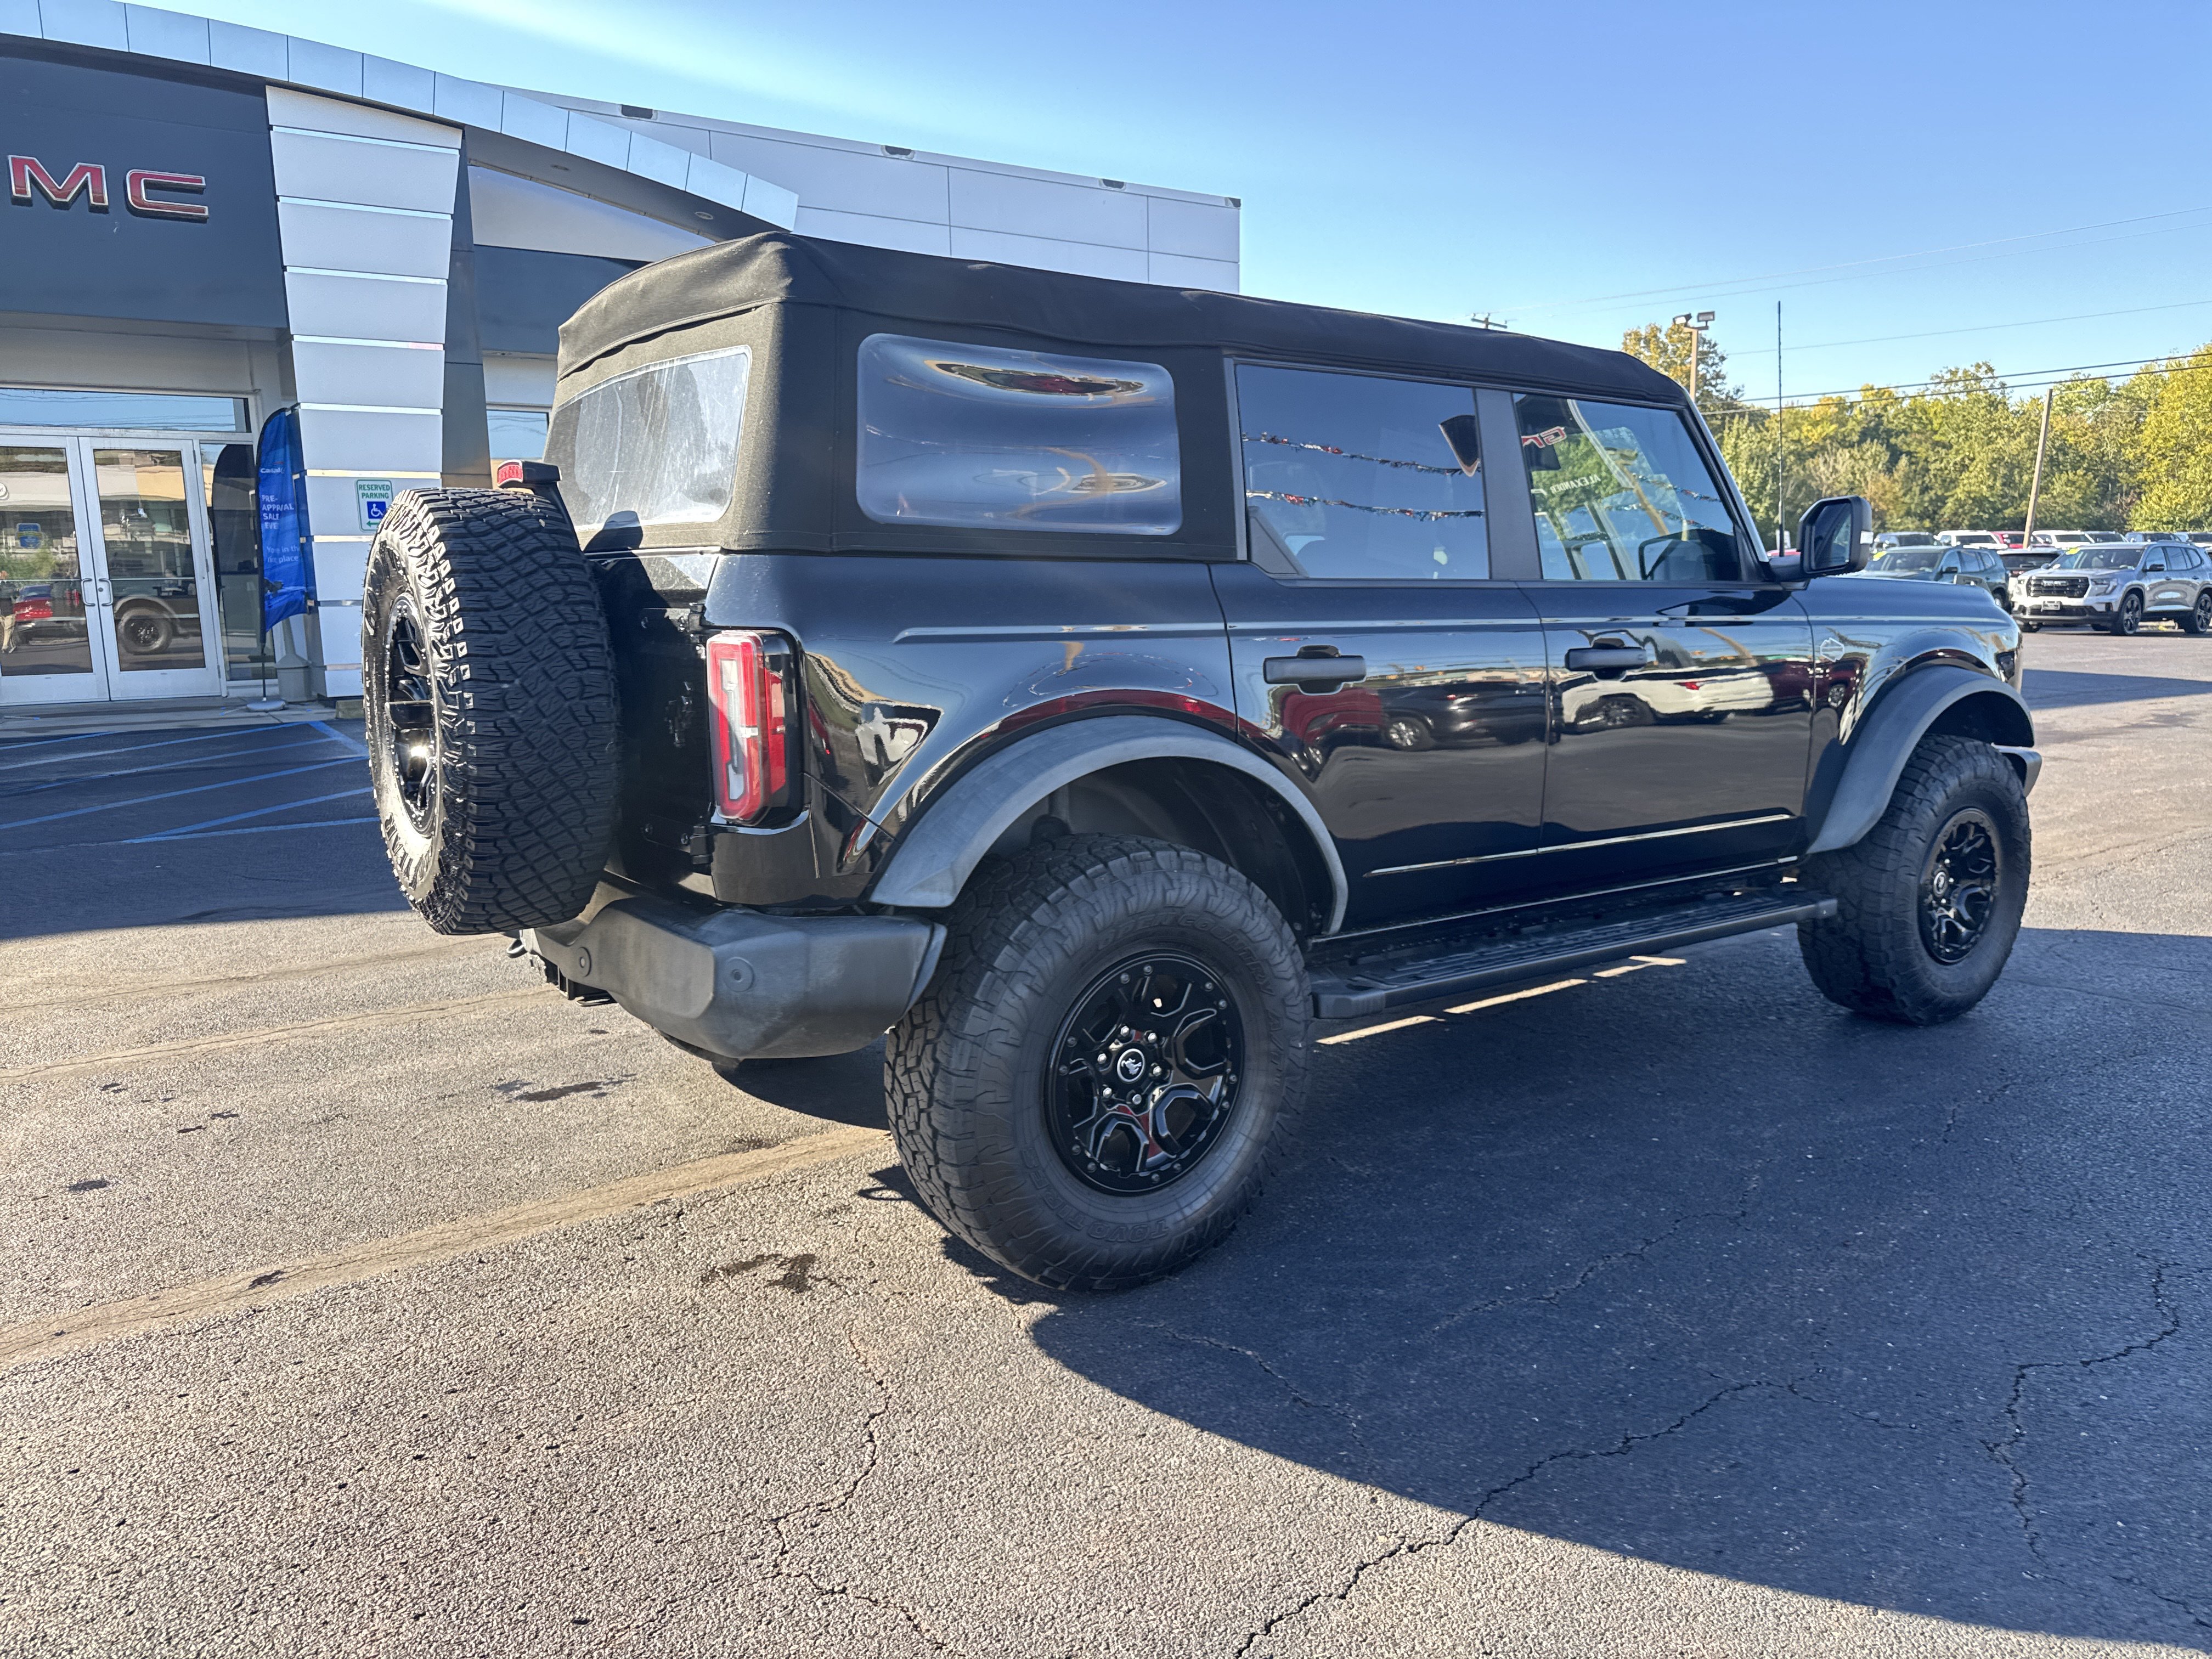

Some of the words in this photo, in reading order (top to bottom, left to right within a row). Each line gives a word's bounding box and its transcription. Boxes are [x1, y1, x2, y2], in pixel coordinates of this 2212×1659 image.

[8, 155, 209, 221] MC
[279, 555, 299, 564] place
[1097, 911, 1176, 950] OPEN
[1178, 913, 1276, 996] COUNTRY
[1020, 1147, 1085, 1231] TIRES
[1086, 1218, 1170, 1243] TOYO
